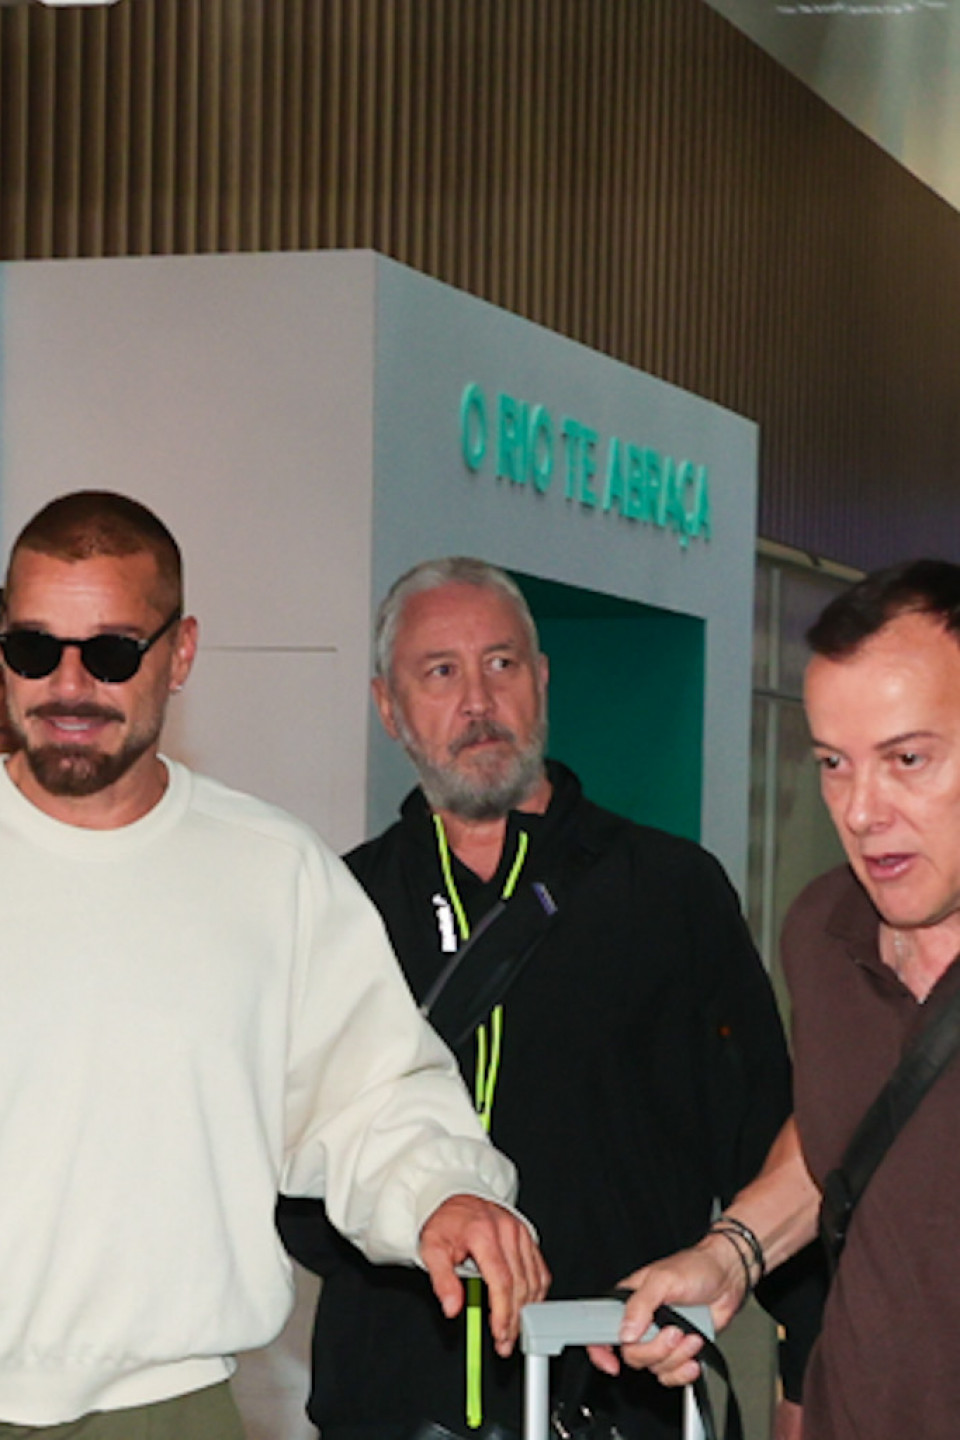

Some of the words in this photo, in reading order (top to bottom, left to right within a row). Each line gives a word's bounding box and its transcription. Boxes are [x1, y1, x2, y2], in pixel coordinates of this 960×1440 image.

[461, 383, 486, 469] O
[496, 394, 552, 492] RIO
[562, 417, 598, 506] TE
[603, 436, 710, 547] ABRAÇA
